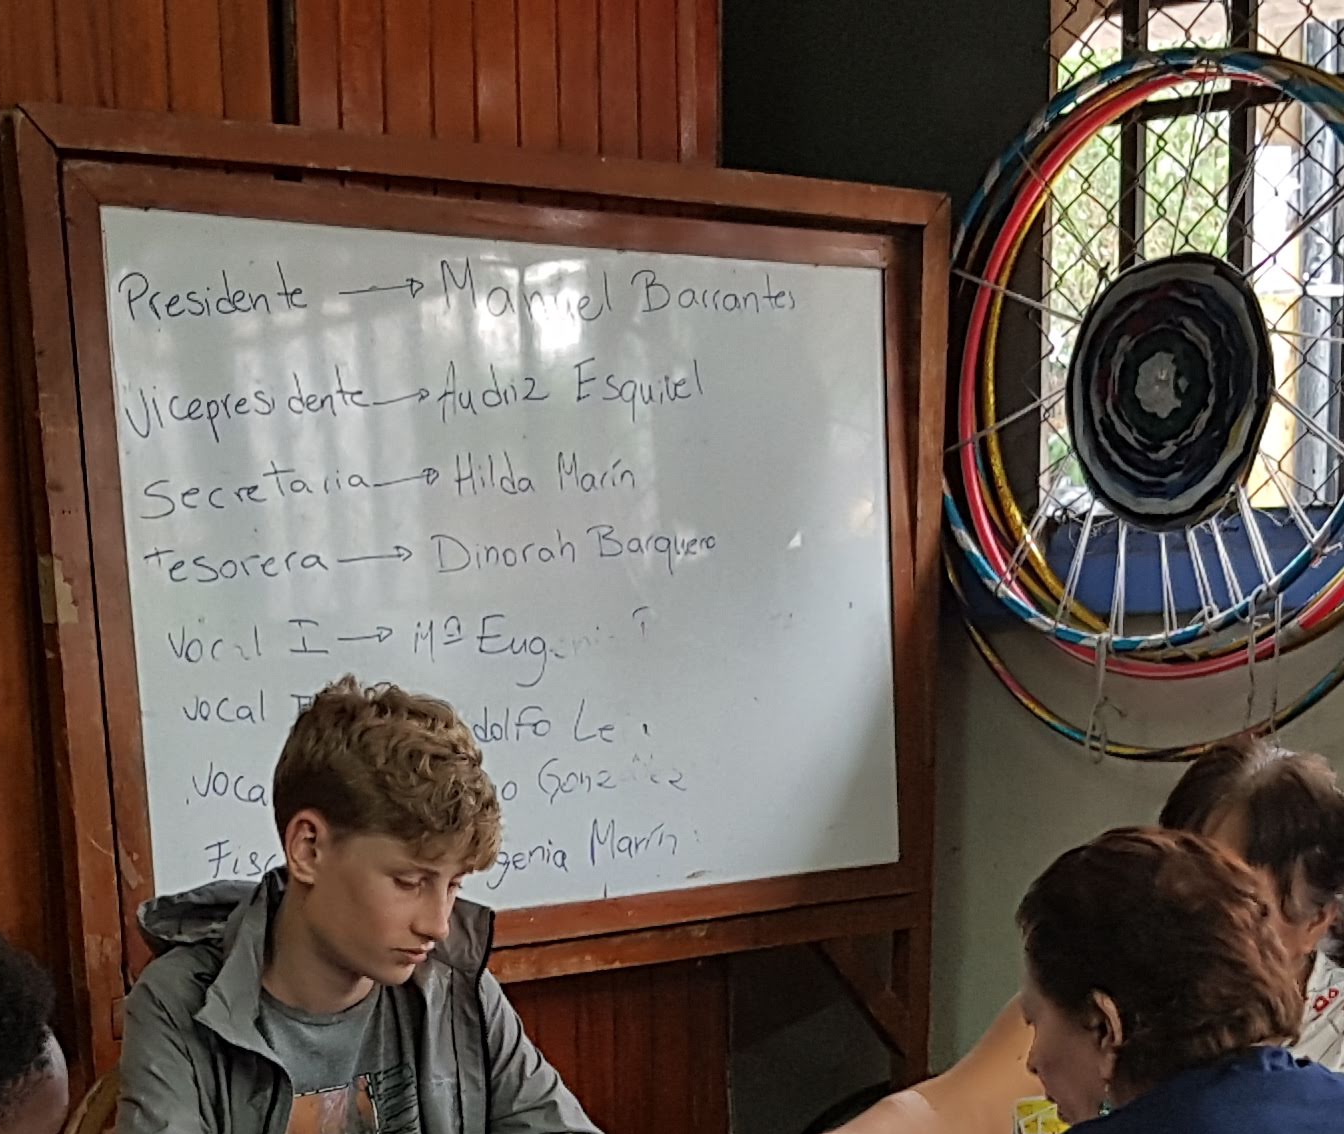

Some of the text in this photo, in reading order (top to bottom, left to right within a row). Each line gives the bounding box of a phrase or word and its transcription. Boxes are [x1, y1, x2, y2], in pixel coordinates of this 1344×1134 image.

[117, 260, 308, 321] Presidente
[630, 268, 796, 314] Barrantes
[140, 451, 636, 519] Secretaria Hilda Marín
[430, 533, 576, 573] Dinorah
[586, 524, 717, 576] Barquero
